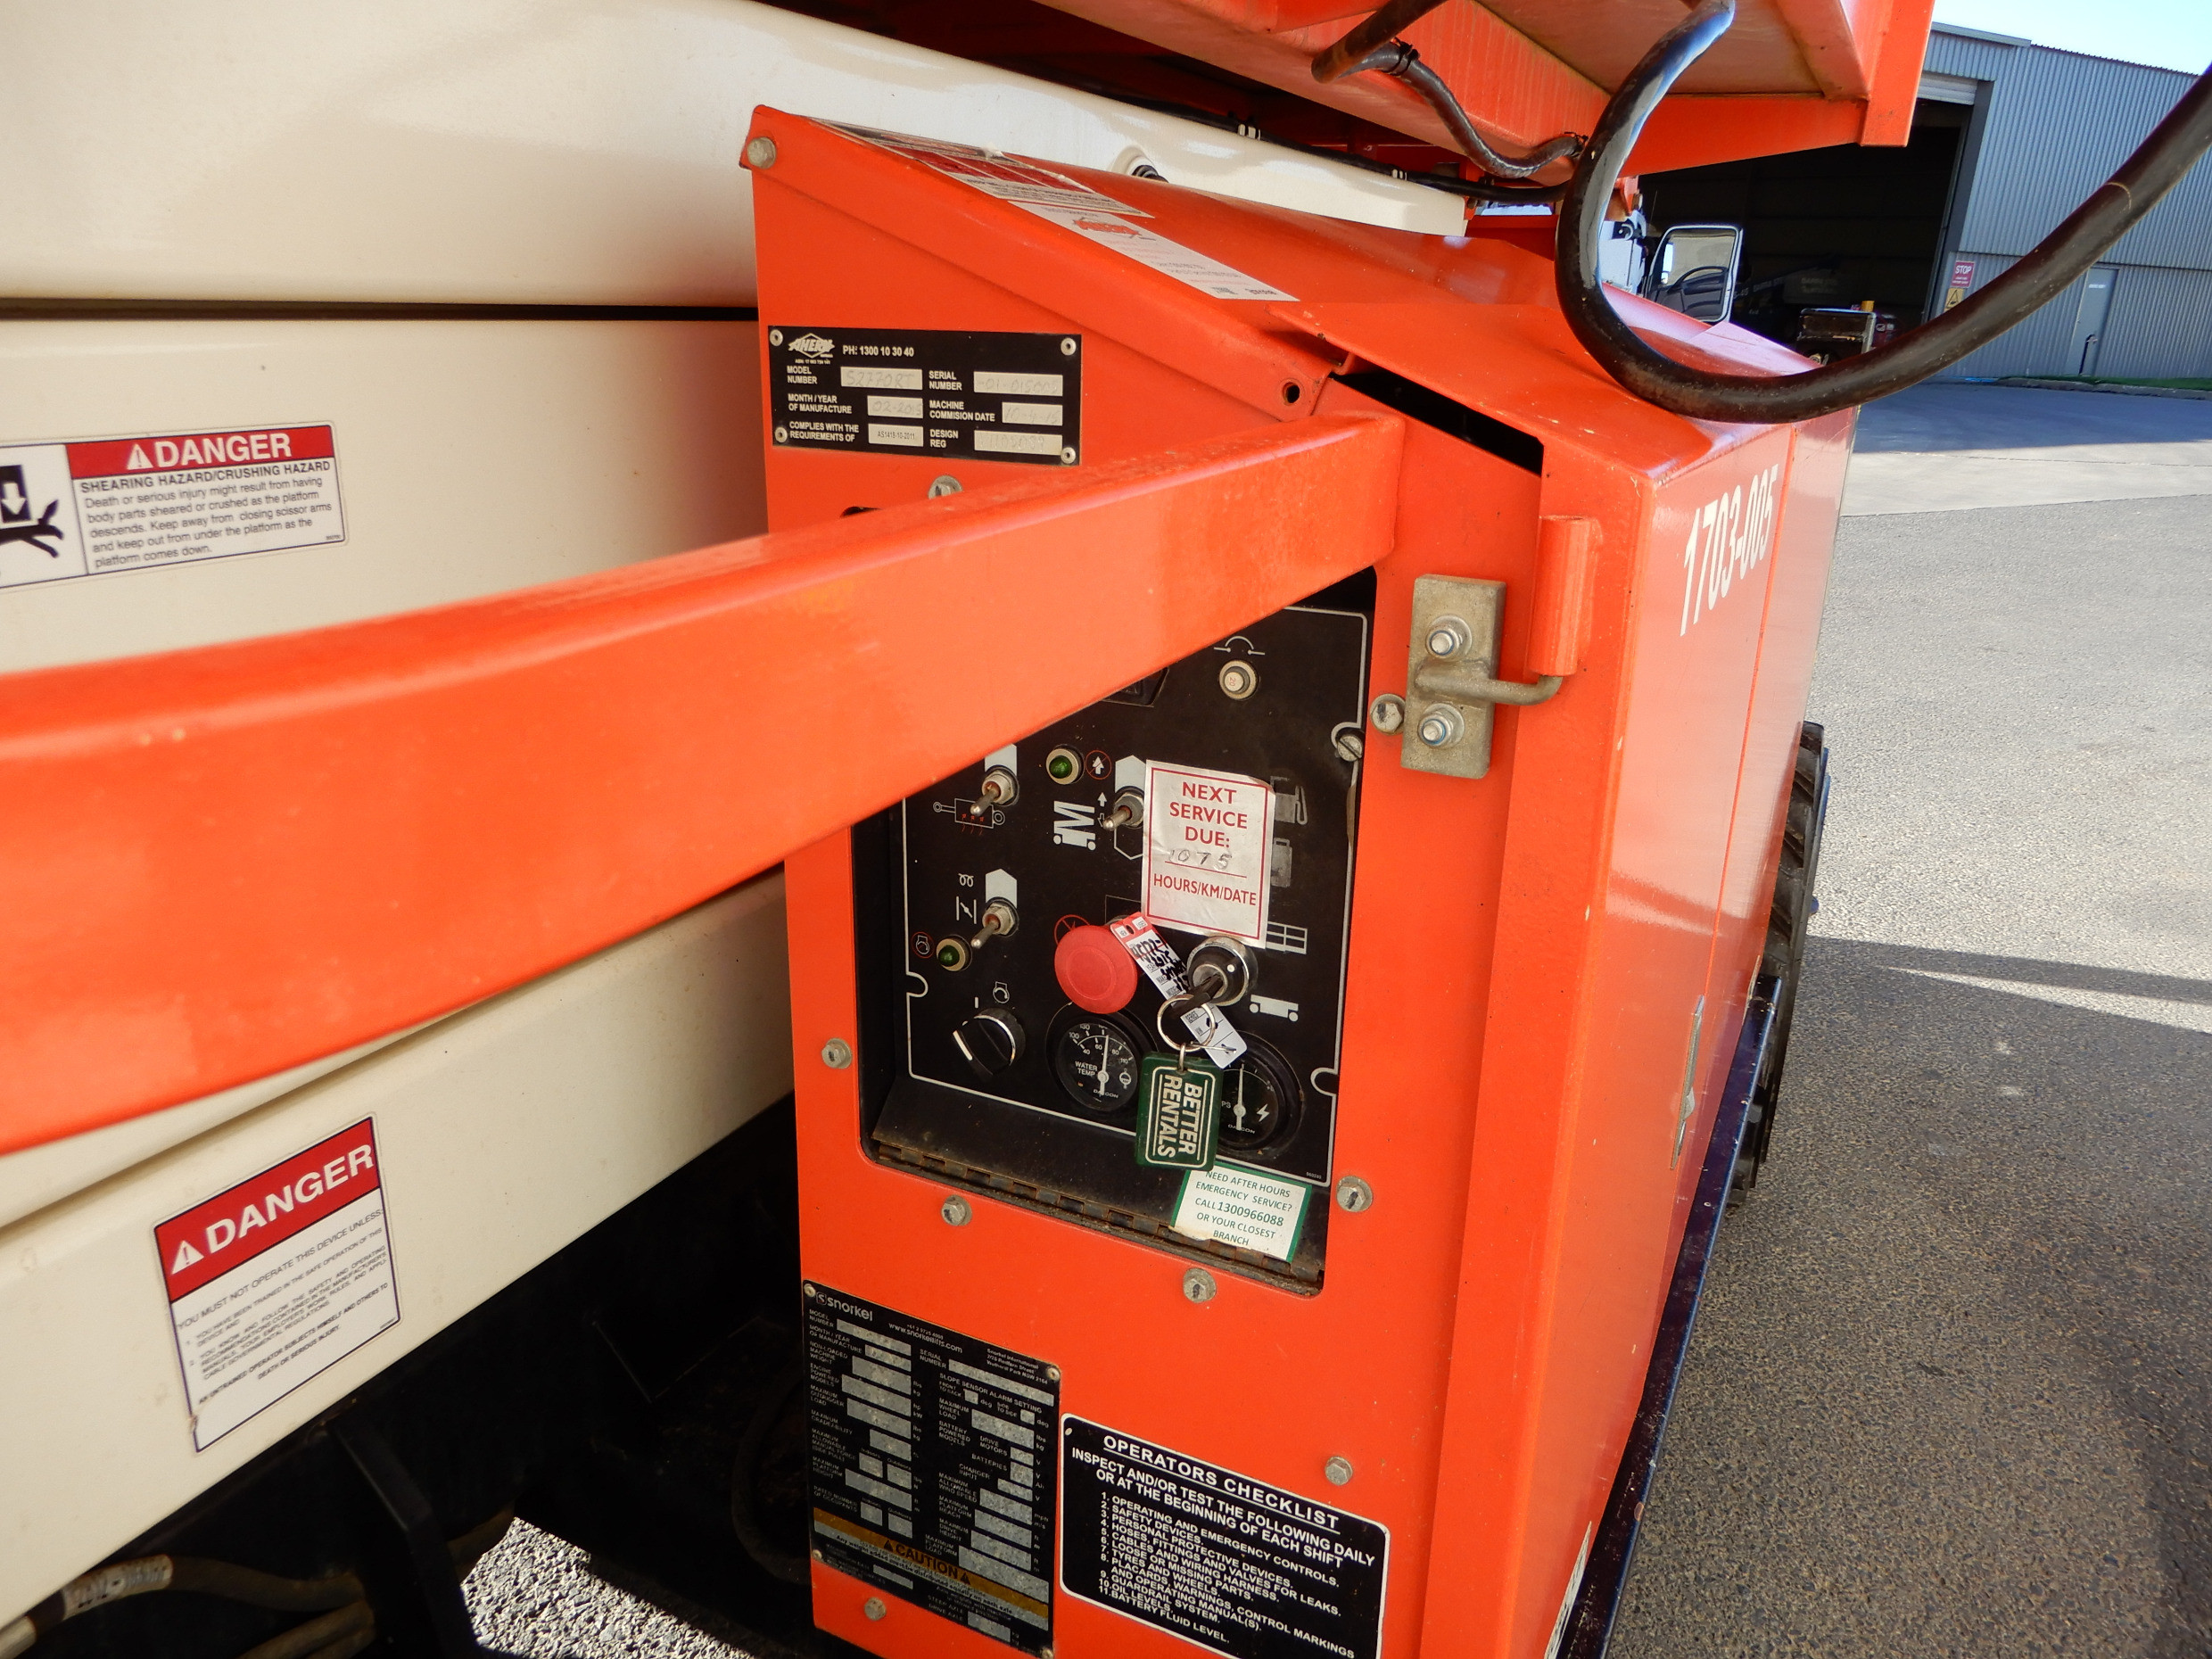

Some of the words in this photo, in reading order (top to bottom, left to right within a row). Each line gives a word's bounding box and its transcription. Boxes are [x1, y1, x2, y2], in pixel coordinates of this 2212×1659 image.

[1954, 265, 1972, 275] STOP
[843, 345, 857, 355] PH:
[860, 346, 879, 356] 1300
[880, 346, 890, 356] 10
[892, 347, 903, 357] 30
[904, 347, 914, 357] 40
[787, 366, 812, 375] MODEL
[788, 376, 817, 384] NUMBER
[929, 370, 956, 380] SERIAL
[929, 381, 962, 391] NUMBER
[788, 393, 813, 402] MONTH
[818, 395, 838, 403] YEAR
[788, 403, 798, 411] OF
[799, 404, 852, 414] MANUFACTURE
[929, 400, 964, 410] MACHINE
[789, 421, 824, 431] COMPLIES
[825, 423, 844, 432] WITH
[845, 424, 859, 433] THE
[929, 410, 973, 420] COMMISION
[975, 412, 995, 422] DATE
[790, 431, 844, 442] REQUIREMENTS
[845, 433, 855, 442] OF
[930, 429, 958, 439] DESIGN
[930, 439, 946, 448] REG
[155, 433, 291, 467] DANGER
[80, 476, 154, 493] SHEARING
[157, 465, 280, 486] HAZARD/CRUSHING
[284, 460, 330, 475] HAZARD
[84, 496, 120, 508] Death
[122, 495, 134, 505] or
[136, 491, 177, 504] serious
[178, 488, 207, 501] injury
[209, 484, 238, 498] might
[239, 482, 267, 493] result
[268, 480, 291, 490] from
[292, 476, 323, 489] having
[87, 511, 115, 524] body
[118, 508, 147, 522] parts
[149, 503, 193, 516] sheared
[194, 503, 206, 512] or
[208, 497, 249, 510] crushed
[251, 497, 263, 506] as
[264, 494, 280, 504] the
[282, 491, 319, 504] platform
[89, 523, 145, 538] descends.
[150, 519, 179, 532] Keep
[181, 517, 209, 529] away
[210, 513, 234, 524] from
[239, 509, 273, 522] closing
[275, 505, 308, 516] scissor
[310, 503, 332, 512] arms
[92, 541, 114, 553] and
[116, 538, 144, 550] keep
[146, 535, 165, 546] out
[166, 532, 191, 543] from
[194, 528, 223, 541] under
[225, 526, 242, 536] the
[243, 522, 283, 535] platform
[285, 520, 296, 529] as
[297, 517, 313, 527] the
[95, 553, 141, 569] platform
[143, 549, 178, 561] comes
[182, 544, 211, 556] down.
[1183, 782, 1236, 804] NEXT
[1170, 802, 1247, 829] SERVICE
[1185, 826, 1229, 848] DUE:
[1154, 874, 1256, 905] HOURS/KM/DATE
[1075, 1061, 1098, 1071] WATER
[1077, 1068, 1095, 1077] TEMP
[1157, 1074, 1183, 1159] RENTALS
[1177, 1082, 1203, 1155] BETTER
[207, 1145, 372, 1252] DANGER
[1196, 1181, 1249, 1201] EMERGENCY
[1252, 1195, 1292, 1212] SERVICE?
[1205, 1171, 1228, 1182] NEED
[1230, 1177, 1258, 1190] AFTER
[1259, 1184, 1291, 1198] HOURS
[1195, 1198, 1216, 1209] CALL
[1217, 1202, 1283, 1226] 1300966088
[1197, 1212, 1209, 1222] OR
[1212, 1216, 1236, 1229] YOUR
[1237, 1223, 1275, 1239] CLOSEST
[1213, 1230, 1249, 1246] BRANCH
[177, 1313, 200, 1331] YOU
[201, 1296, 227, 1318] MUST
[229, 1283, 250, 1301] NOT
[251, 1259, 293, 1289] OPERATE
[295, 1246, 316, 1263] THIS
[317, 1227, 348, 1251] DEVICE
[828, 1297, 872, 1321] snorkel
[1104, 1436, 1217, 1485] OPERATORS
[1225, 1479, 1339, 1528] CHECKLIST
[1072, 1448, 1125, 1474] INSPECT
[1127, 1468, 1176, 1495] AND/OR
[1180, 1487, 1214, 1507] TEST
[1217, 1499, 1243, 1519] THE
[1248, 1511, 1330, 1550] FOLLOWING
[1334, 1543, 1374, 1566] DAILY
[1096, 1469, 1114, 1484] OR
[1117, 1477, 1133, 1490] AT
[1135, 1482, 1160, 1501] THE
[1164, 1493, 1236, 1529] BEGINNING
[1240, 1522, 1259, 1536] OF
[1262, 1530, 1300, 1553] EACH
[1303, 1545, 1342, 1568] SHIFT
[1112, 1505, 1152, 1525] SAFETY
[1155, 1521, 1203, 1545] DEVICES.
[1112, 1496, 1172, 1523] OPERATING
[1175, 1520, 1198, 1533] AND
[1201, 1529, 1271, 1560] EMERGENCY
[1274, 1556, 1339, 1587] CONTROLS.
[1112, 1514, 1168, 1541] PERSONAL
[1172, 1536, 1239, 1568] PROTECTIVE
[1242, 1563, 1292, 1589] DEVICES.
[896, 1543, 958, 1579] CAUTION
[1112, 1532, 1153, 1553] CABLES
[1156, 1548, 1179, 1563] AND
[1181, 1557, 1220, 1579] WIRING
[1224, 1574, 1279, 1602] HARNESS.
[1112, 1523, 1150, 1544] HOSES,
[1153, 1538, 1201, 1562] FITTINGS
[1203, 1557, 1226, 1572] AND
[1229, 1566, 1271, 1589] VALVES
[1274, 1584, 1297, 1600] FOR
[1300, 1594, 1341, 1616] LEAKS.
[1112, 1540, 1147, 1560] LOOSE
[1150, 1555, 1166, 1566] OR
[1168, 1562, 1212, 1585] MISSING
[1216, 1580, 1253, 1601] PARTS.
[1112, 1548, 1145, 1567] TYRES
[1148, 1564, 1170, 1577] AND
[1173, 1572, 1220, 1597] WHEELS.
[1111, 1566, 1134, 1580] AND
[1135, 1575, 1196, 1605] OPERATING
[1198, 1600, 1261, 1630] MANUAL(S).
[1111, 1574, 1172, 1604] GUARDRAIL
[1175, 1599, 1220, 1623] SYSTEM.
[1112, 1557, 1170, 1587] PLACARDS,
[1172, 1581, 1234, 1612] WARNINGS,
[1237, 1606, 1291, 1633] CONTROL
[1294, 1629, 1354, 1659] MARKINGS
[1131, 1590, 1173, 1613] LEVELS.
[1160, 1609, 1191, 1627] FLUID
[1193, 1622, 1229, 1643] LEVEL.
